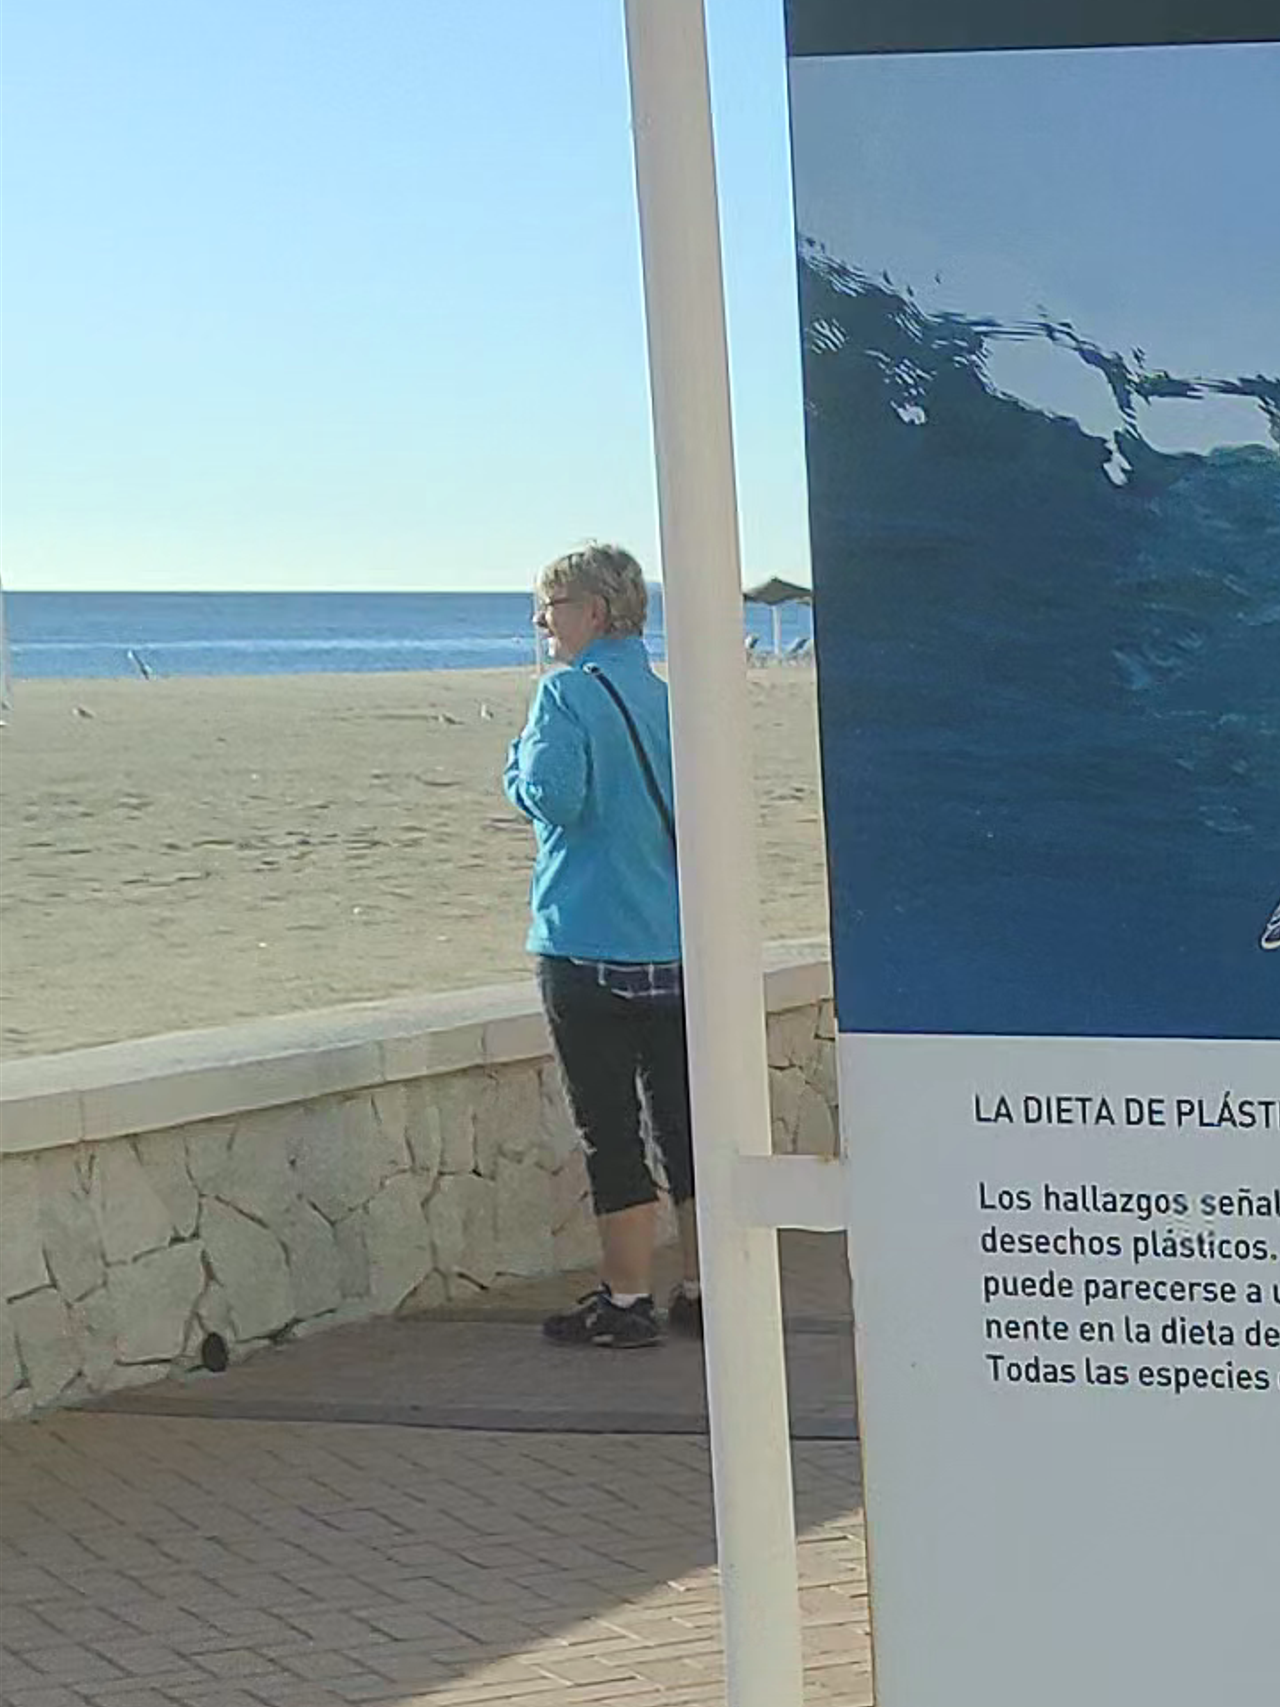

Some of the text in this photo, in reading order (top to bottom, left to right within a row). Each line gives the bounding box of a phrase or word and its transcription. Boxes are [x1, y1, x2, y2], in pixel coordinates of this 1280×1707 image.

[974, 1093, 1014, 1124] LA
[1023, 1095, 1116, 1126] DIETA
[1124, 1097, 1167, 1127] DE
[979, 1181, 1032, 1211] Los
[1044, 1183, 1189, 1222] hallazgos
[980, 1225, 1122, 1257] desechos
[1133, 1228, 1278, 1266] plásticos.
[983, 1269, 1074, 1304] puede
[1084, 1278, 1237, 1307] parecerse
[1245, 1282, 1263, 1304] a
[985, 1314, 1069, 1342] nente
[1079, 1321, 1115, 1343] en
[1124, 1314, 1151, 1344] la
[1161, 1316, 1235, 1346] dieta
[1245, 1319, 1280, 1348] de
[985, 1353, 1076, 1384] Todas
[1085, 1356, 1130, 1386] las
[1138, 1360, 1270, 1395] especies
